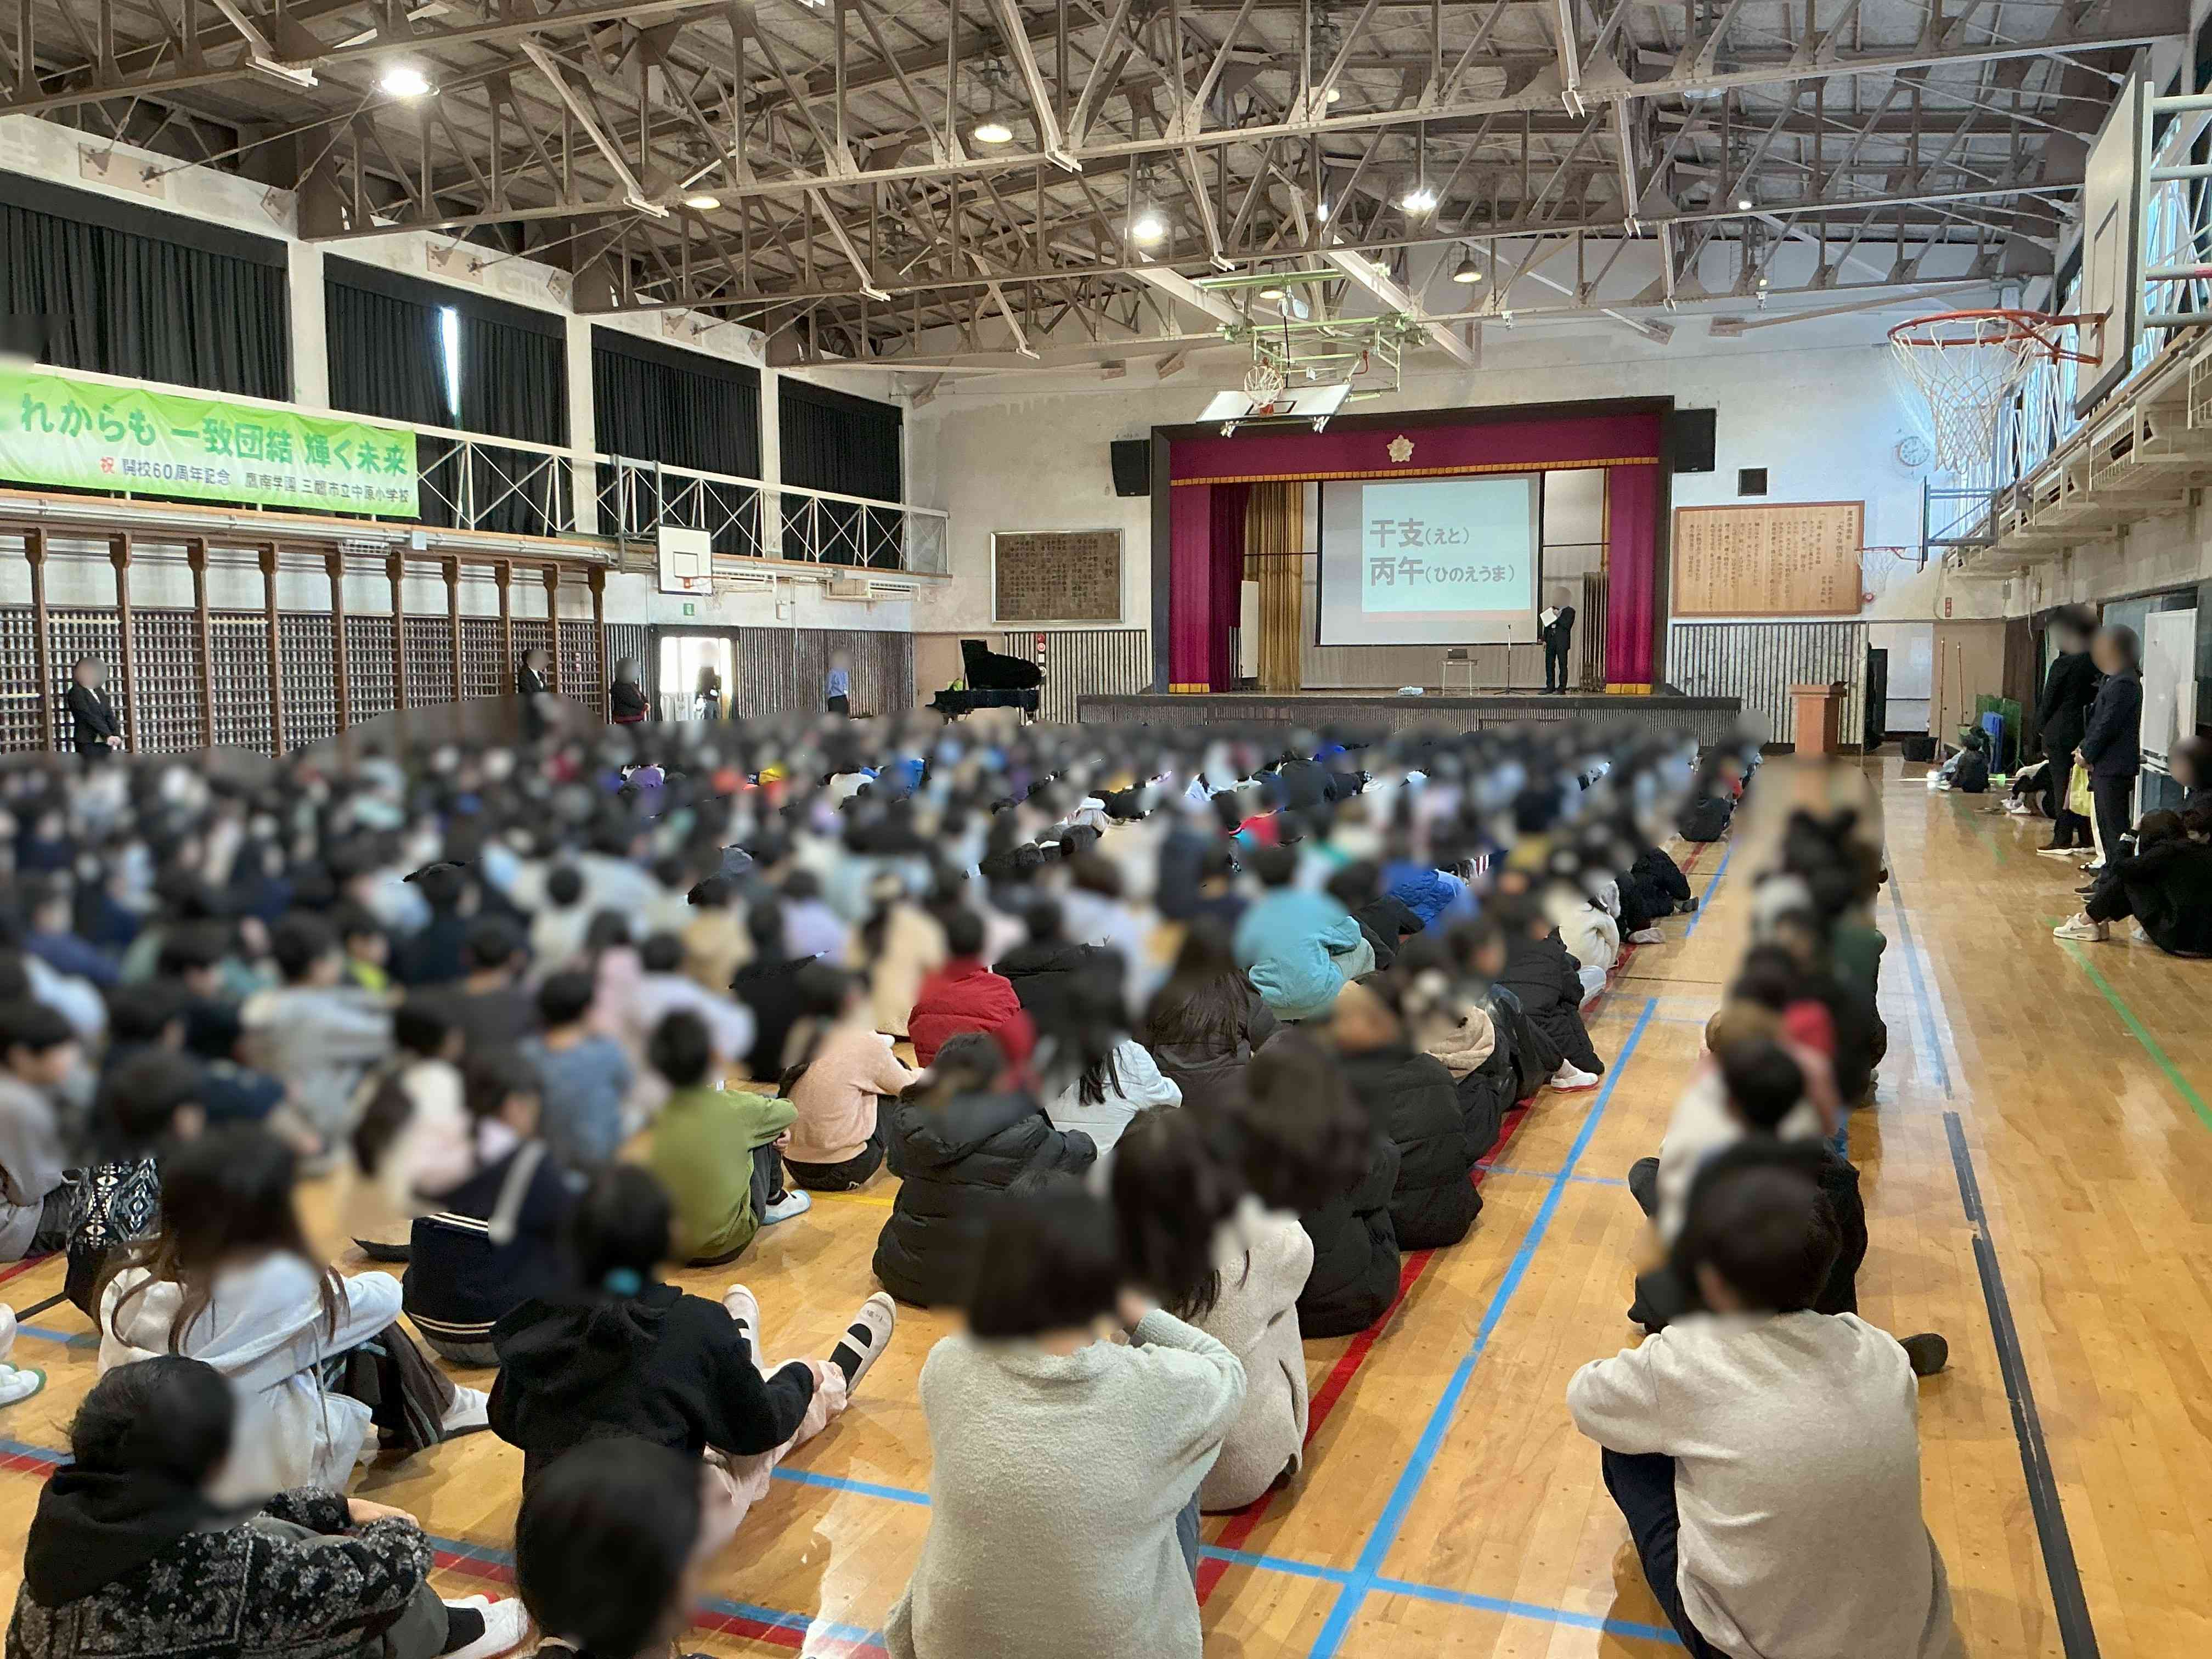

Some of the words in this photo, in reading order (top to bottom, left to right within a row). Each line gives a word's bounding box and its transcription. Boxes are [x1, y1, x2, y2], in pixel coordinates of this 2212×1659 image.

[0, 392, 156, 445] れからも
[171, 417, 292, 464] 一致団結
[303, 432, 409, 477] 輝く未来
[100, 456, 115, 474] 祝
[121, 458, 231, 486] 開校60周年記念
[1369, 517, 1470, 548] 干支（えと）
[1369, 556, 1515, 586] 丙午（ひのえうま）
